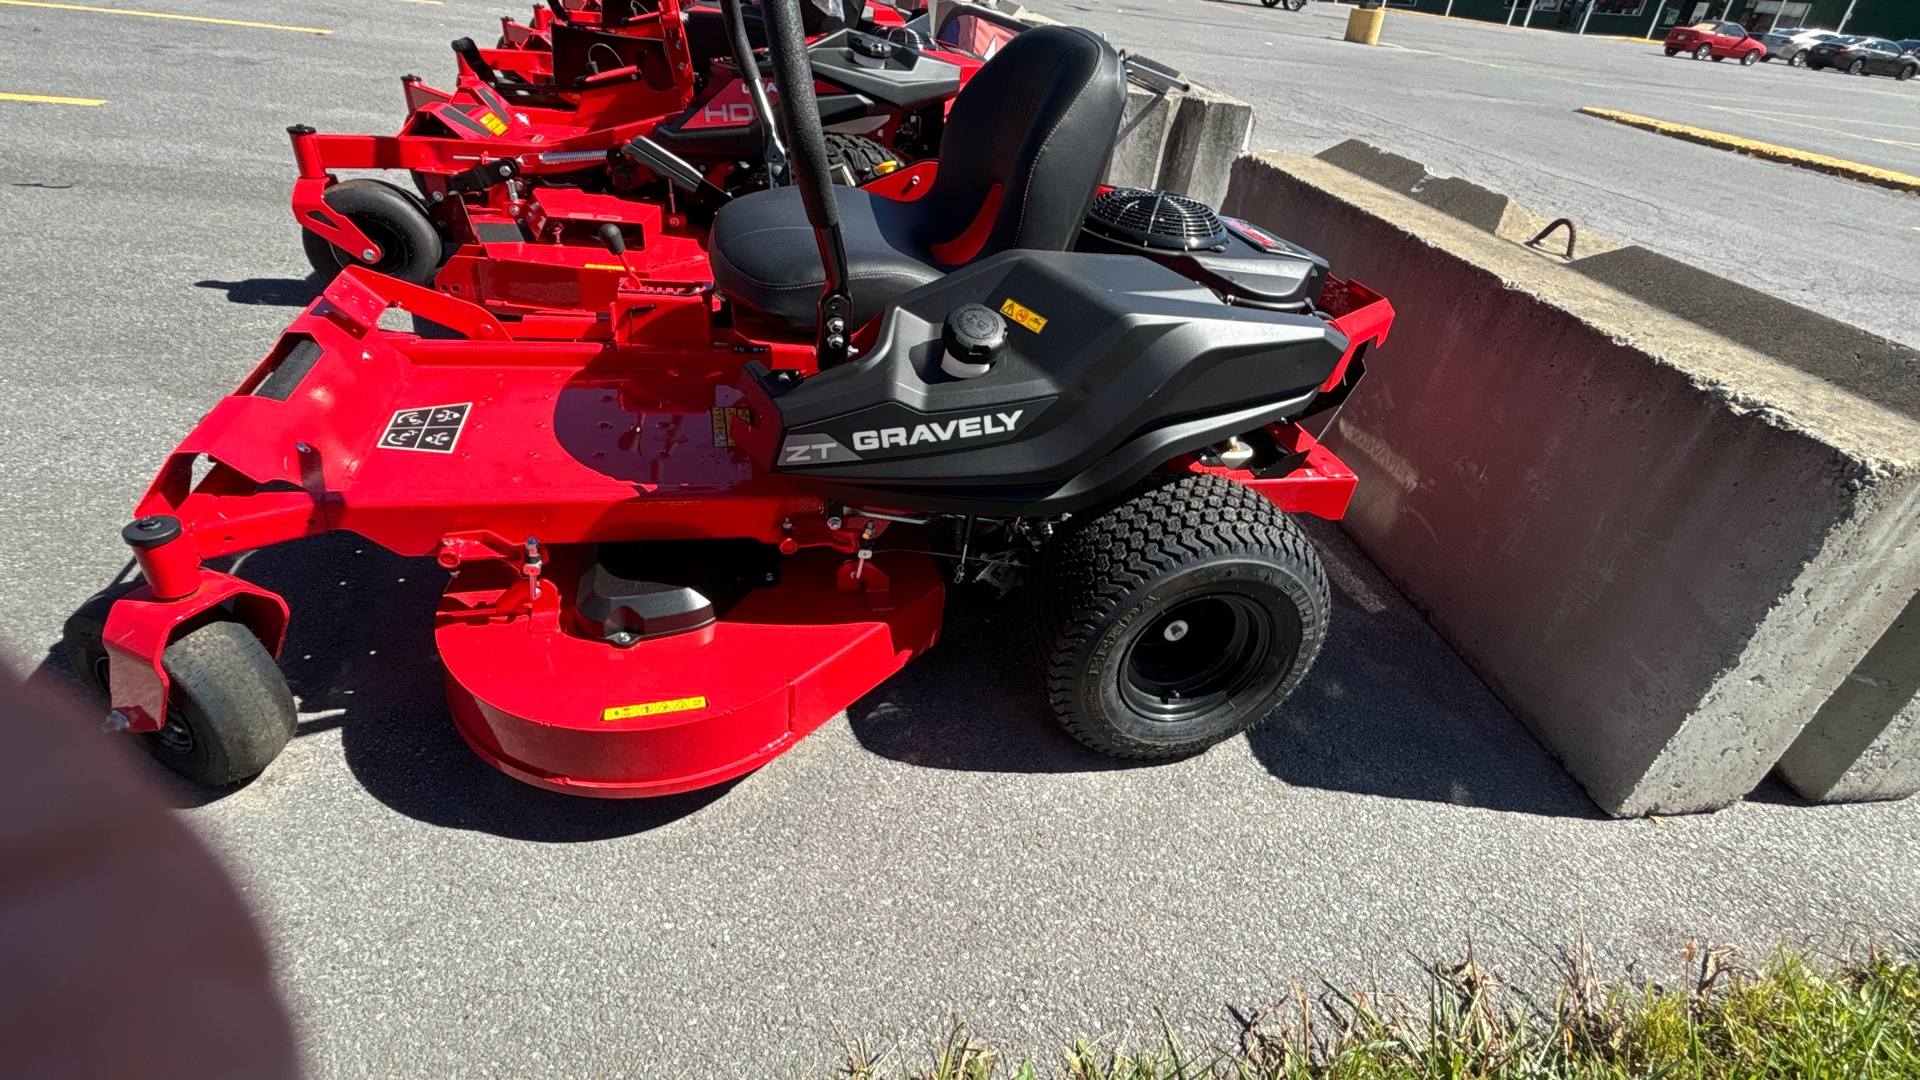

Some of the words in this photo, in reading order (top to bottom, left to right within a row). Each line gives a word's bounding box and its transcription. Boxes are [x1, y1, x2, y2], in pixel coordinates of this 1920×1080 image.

[704, 103, 753, 122] HD
[786, 442, 838, 462] ZT
[852, 410, 1024, 451] GRAVELY
[1088, 594, 1158, 674] KENDA
[1279, 578, 1317, 641] SUPER
